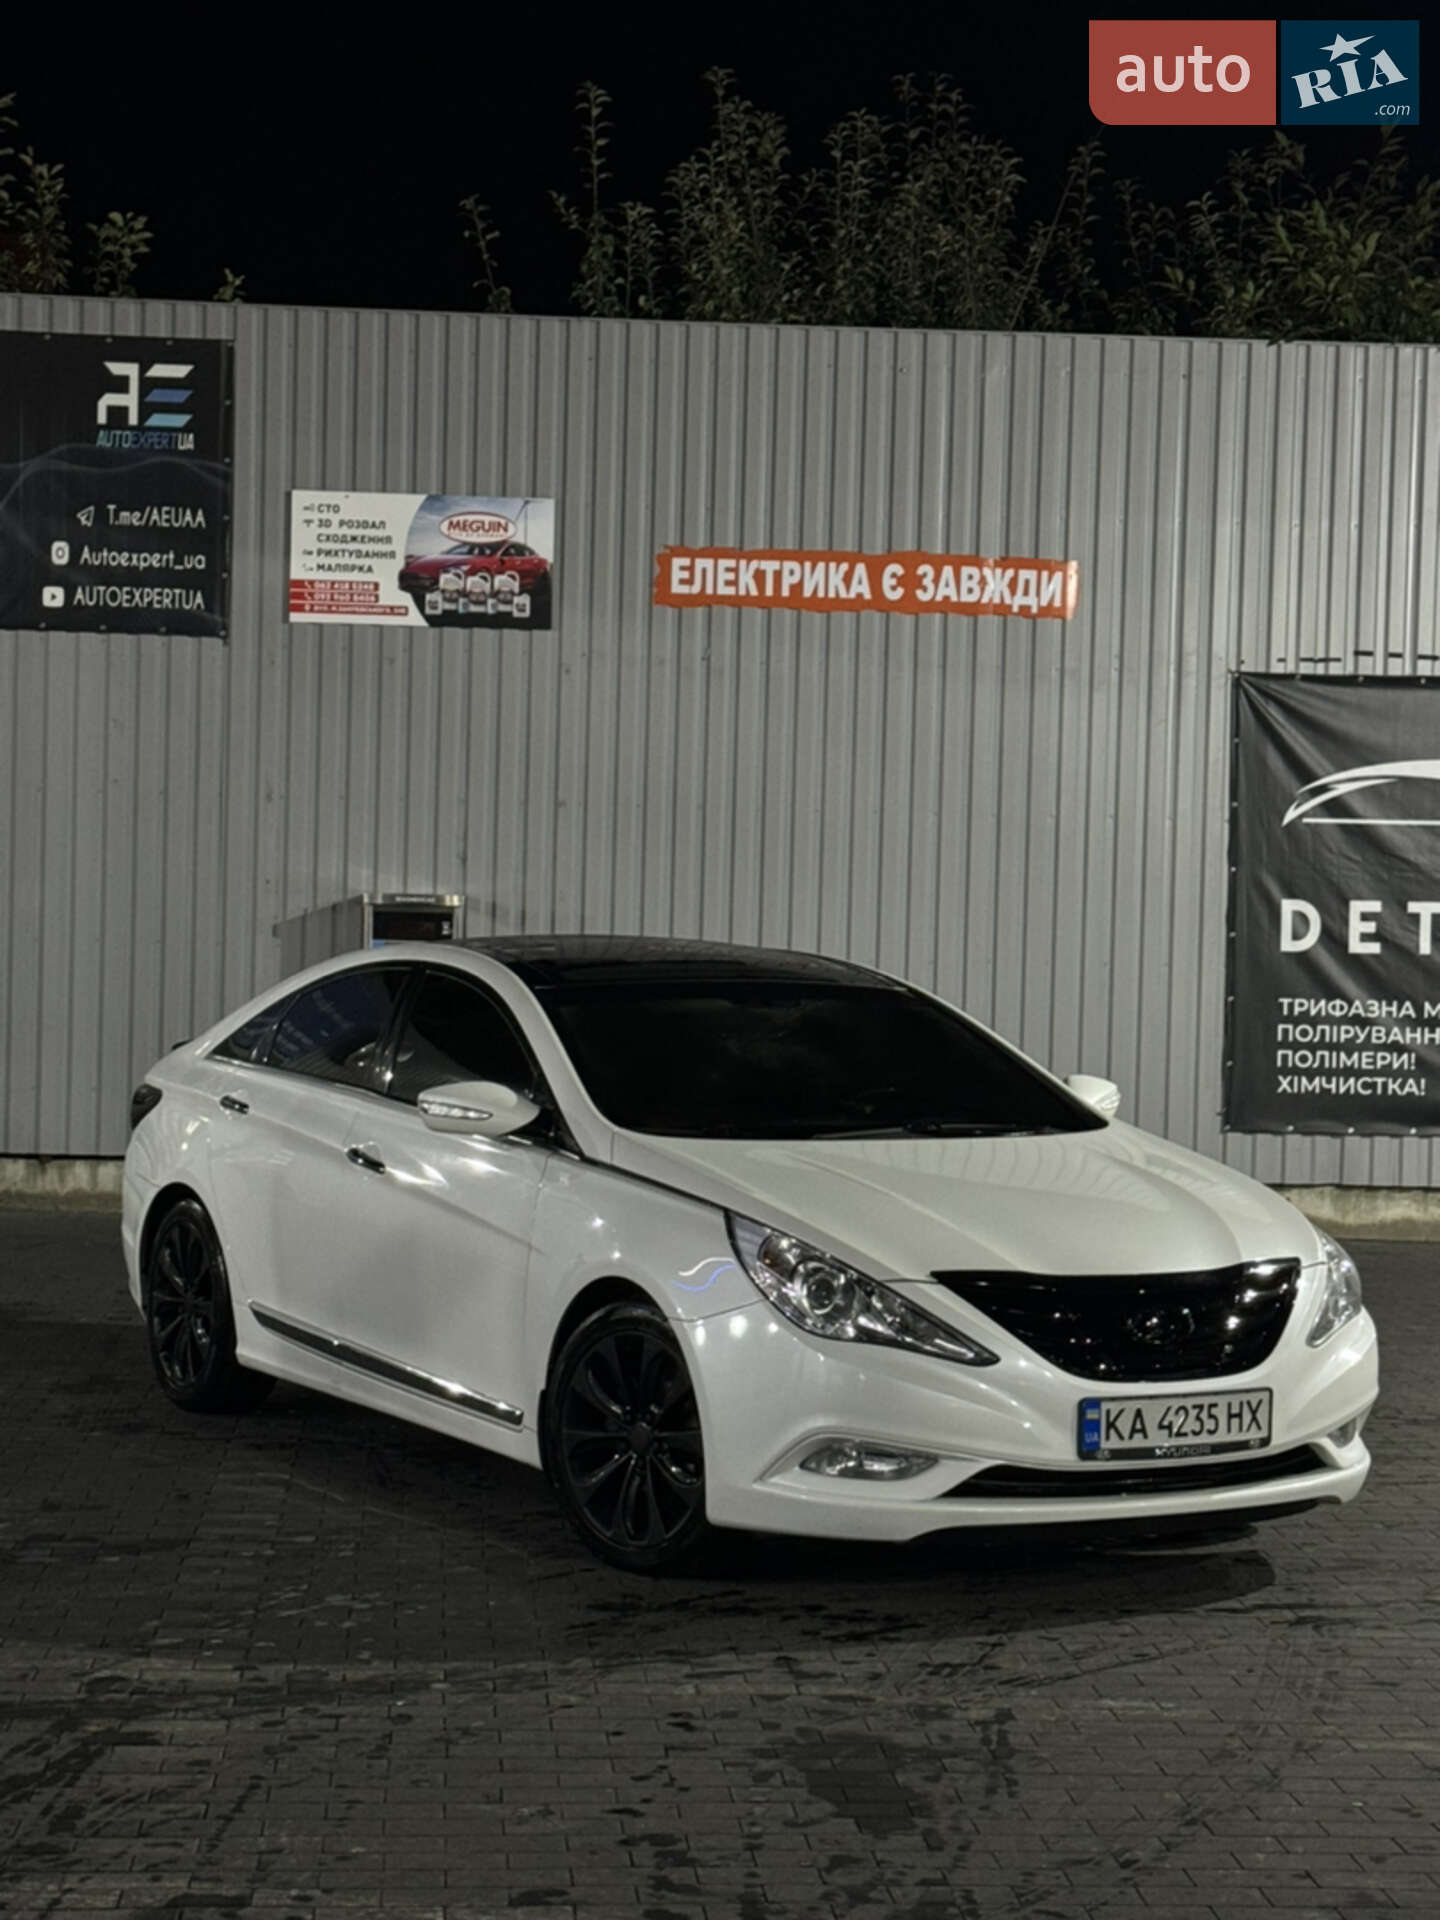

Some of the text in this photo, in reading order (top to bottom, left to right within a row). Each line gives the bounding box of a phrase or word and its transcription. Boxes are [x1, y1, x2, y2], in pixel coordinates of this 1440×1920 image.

[107, 504, 206, 528] T.me/AEUAA
[316, 503, 341, 514] СТО
[338, 519, 386, 530] РОЗВАЛ
[447, 519, 509, 533] MEGUIN
[316, 533, 393, 545] СХОДЖЕННЯ
[80, 545, 206, 571] Autoexpert_ua
[316, 548, 396, 560] РИХТУВАННЯ
[316, 563, 374, 574] МАЛЯРКА
[670, 557, 1063, 614] ЕЛЕКТРИКА Є ЗАВЖДИ
[73, 586, 205, 610] AUTOEXPERTUA
[1280, 899, 1440, 956] DET
[1278, 997, 1416, 1019] ТРИФАЗНА
[1277, 1023, 1440, 1045] ПОЛІРУВАНН
[1276, 1049, 1416, 1070] ПОЛІМЕРИ!
[1276, 1074, 1426, 1096] ХІМЧИСТКА!
[1105, 1398, 1264, 1442] KA 4235 HX
